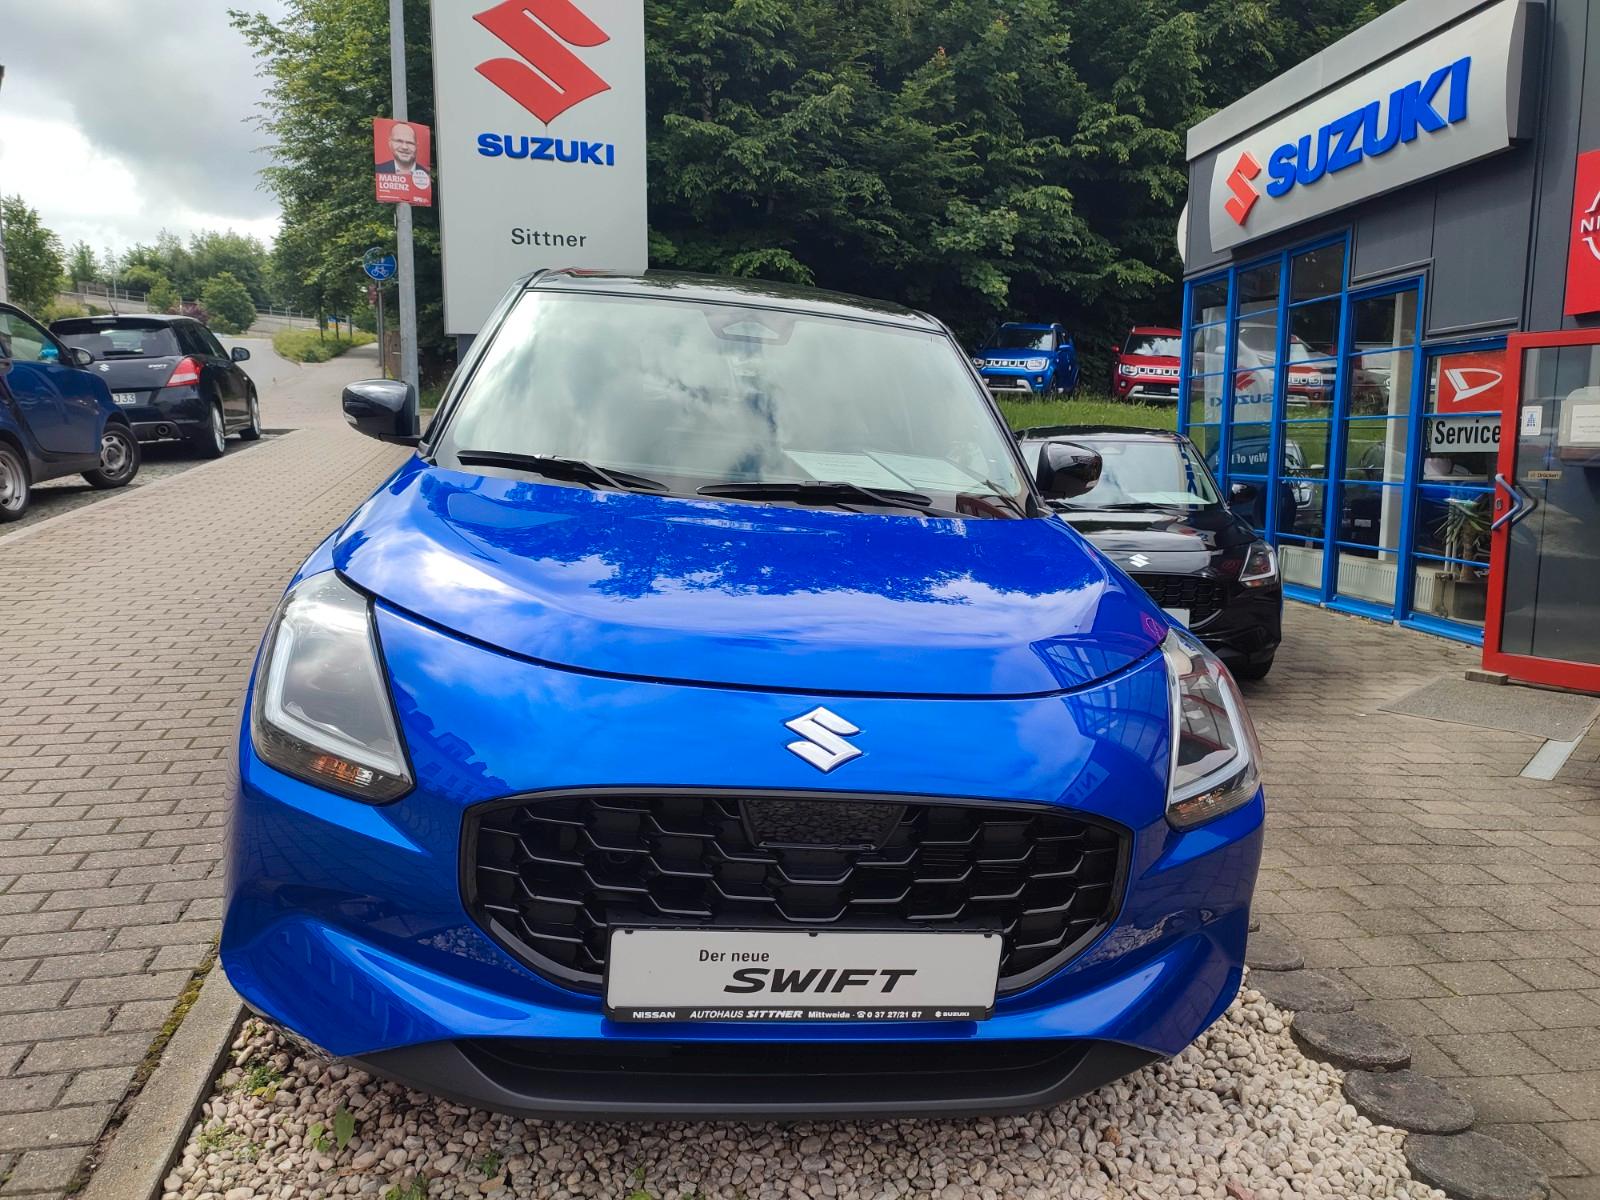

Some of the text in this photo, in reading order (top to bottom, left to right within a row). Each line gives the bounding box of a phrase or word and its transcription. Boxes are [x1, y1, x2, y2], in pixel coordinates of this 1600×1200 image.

[1267, 56, 1471, 198] SUZUKI
[477, 132, 615, 166] SUZUKI
[378, 173, 407, 183] MARIO
[378, 181, 410, 192] LORENZ
[511, 228, 588, 248] Sittner
[1434, 418, 1501, 445] Service
[699, 949, 770, 962] Der neue
[724, 967, 917, 993] SWIFT
[632, 1011, 676, 1019] NISSAN
[690, 1010, 744, 1019] AUTOHAUS
[745, 1010, 804, 1019] SITTNER
[807, 1010, 849, 1019] Mittweida
[887, 1011, 909, 1019] 27/21
